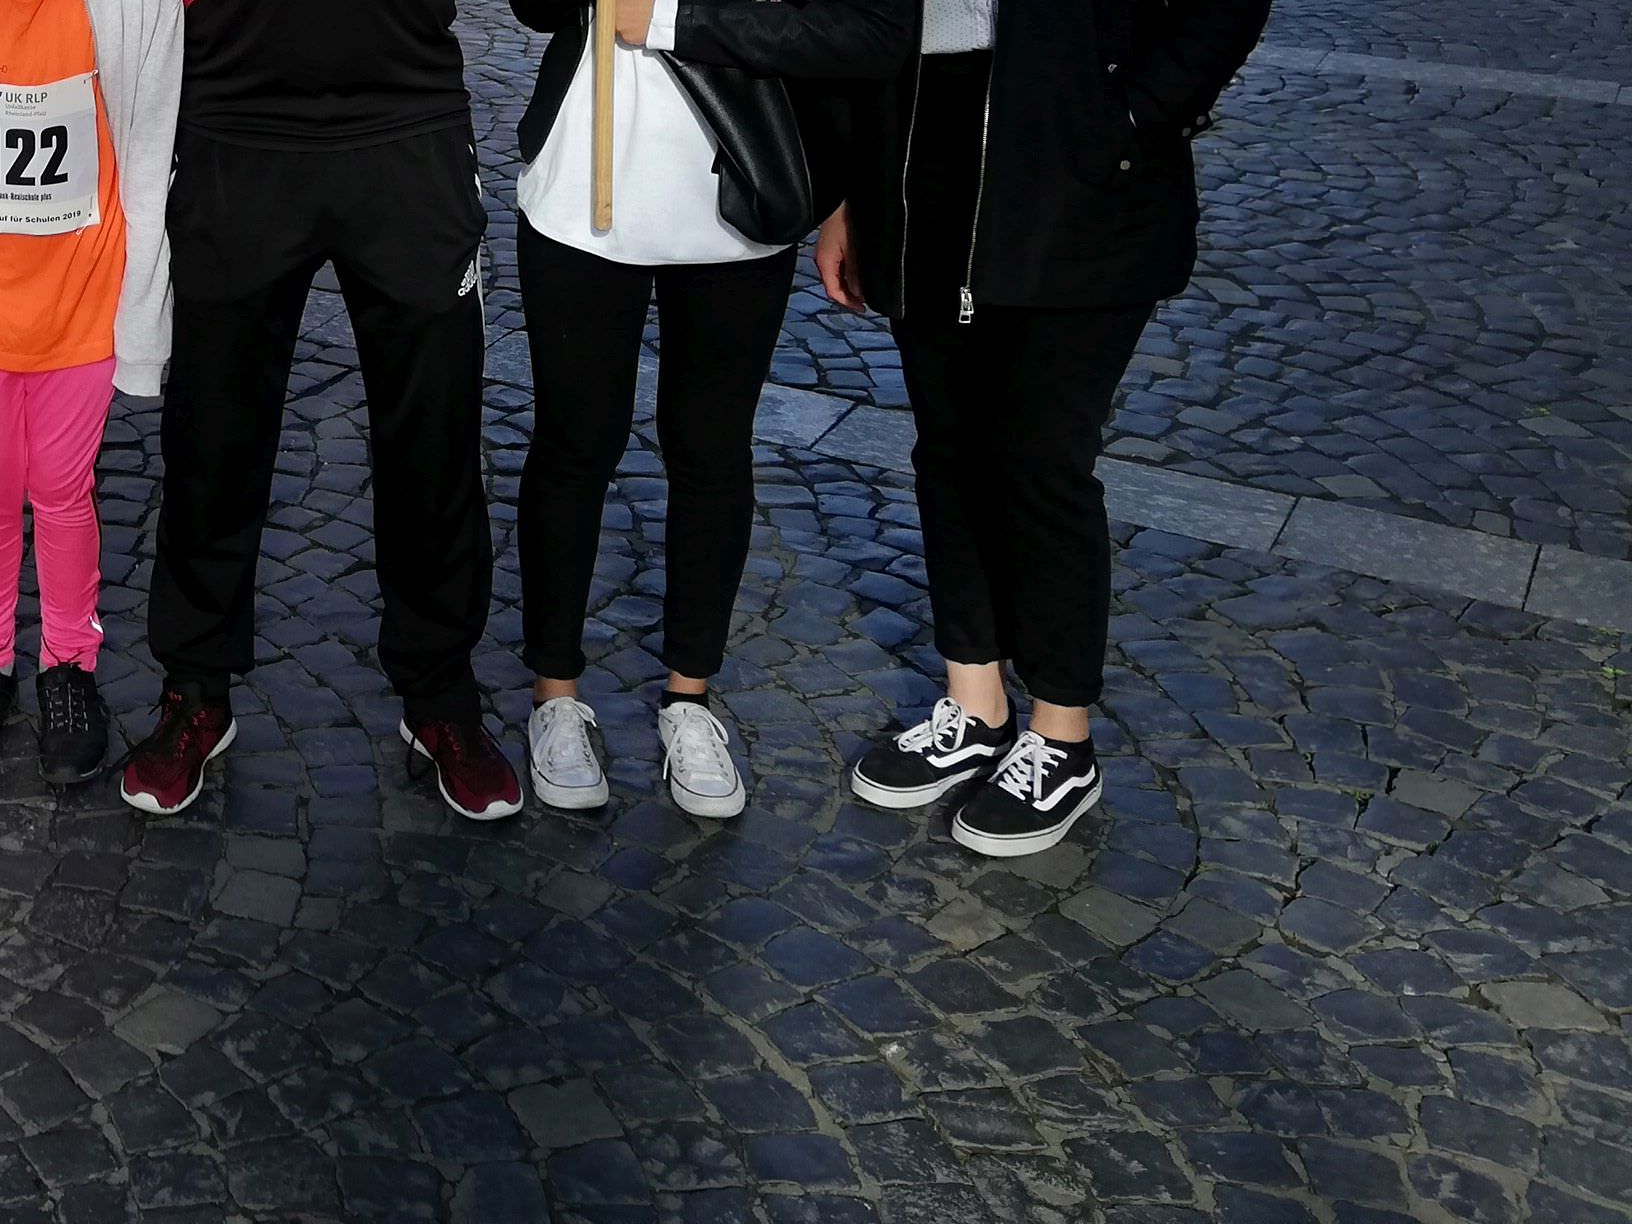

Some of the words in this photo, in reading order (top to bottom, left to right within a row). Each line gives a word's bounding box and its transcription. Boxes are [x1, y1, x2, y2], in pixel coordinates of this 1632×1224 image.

[5, 92, 22, 104] UK
[25, 92, 48, 104] RLP
[10, 215, 22, 223] für
[62, 210, 82, 221] 2019
